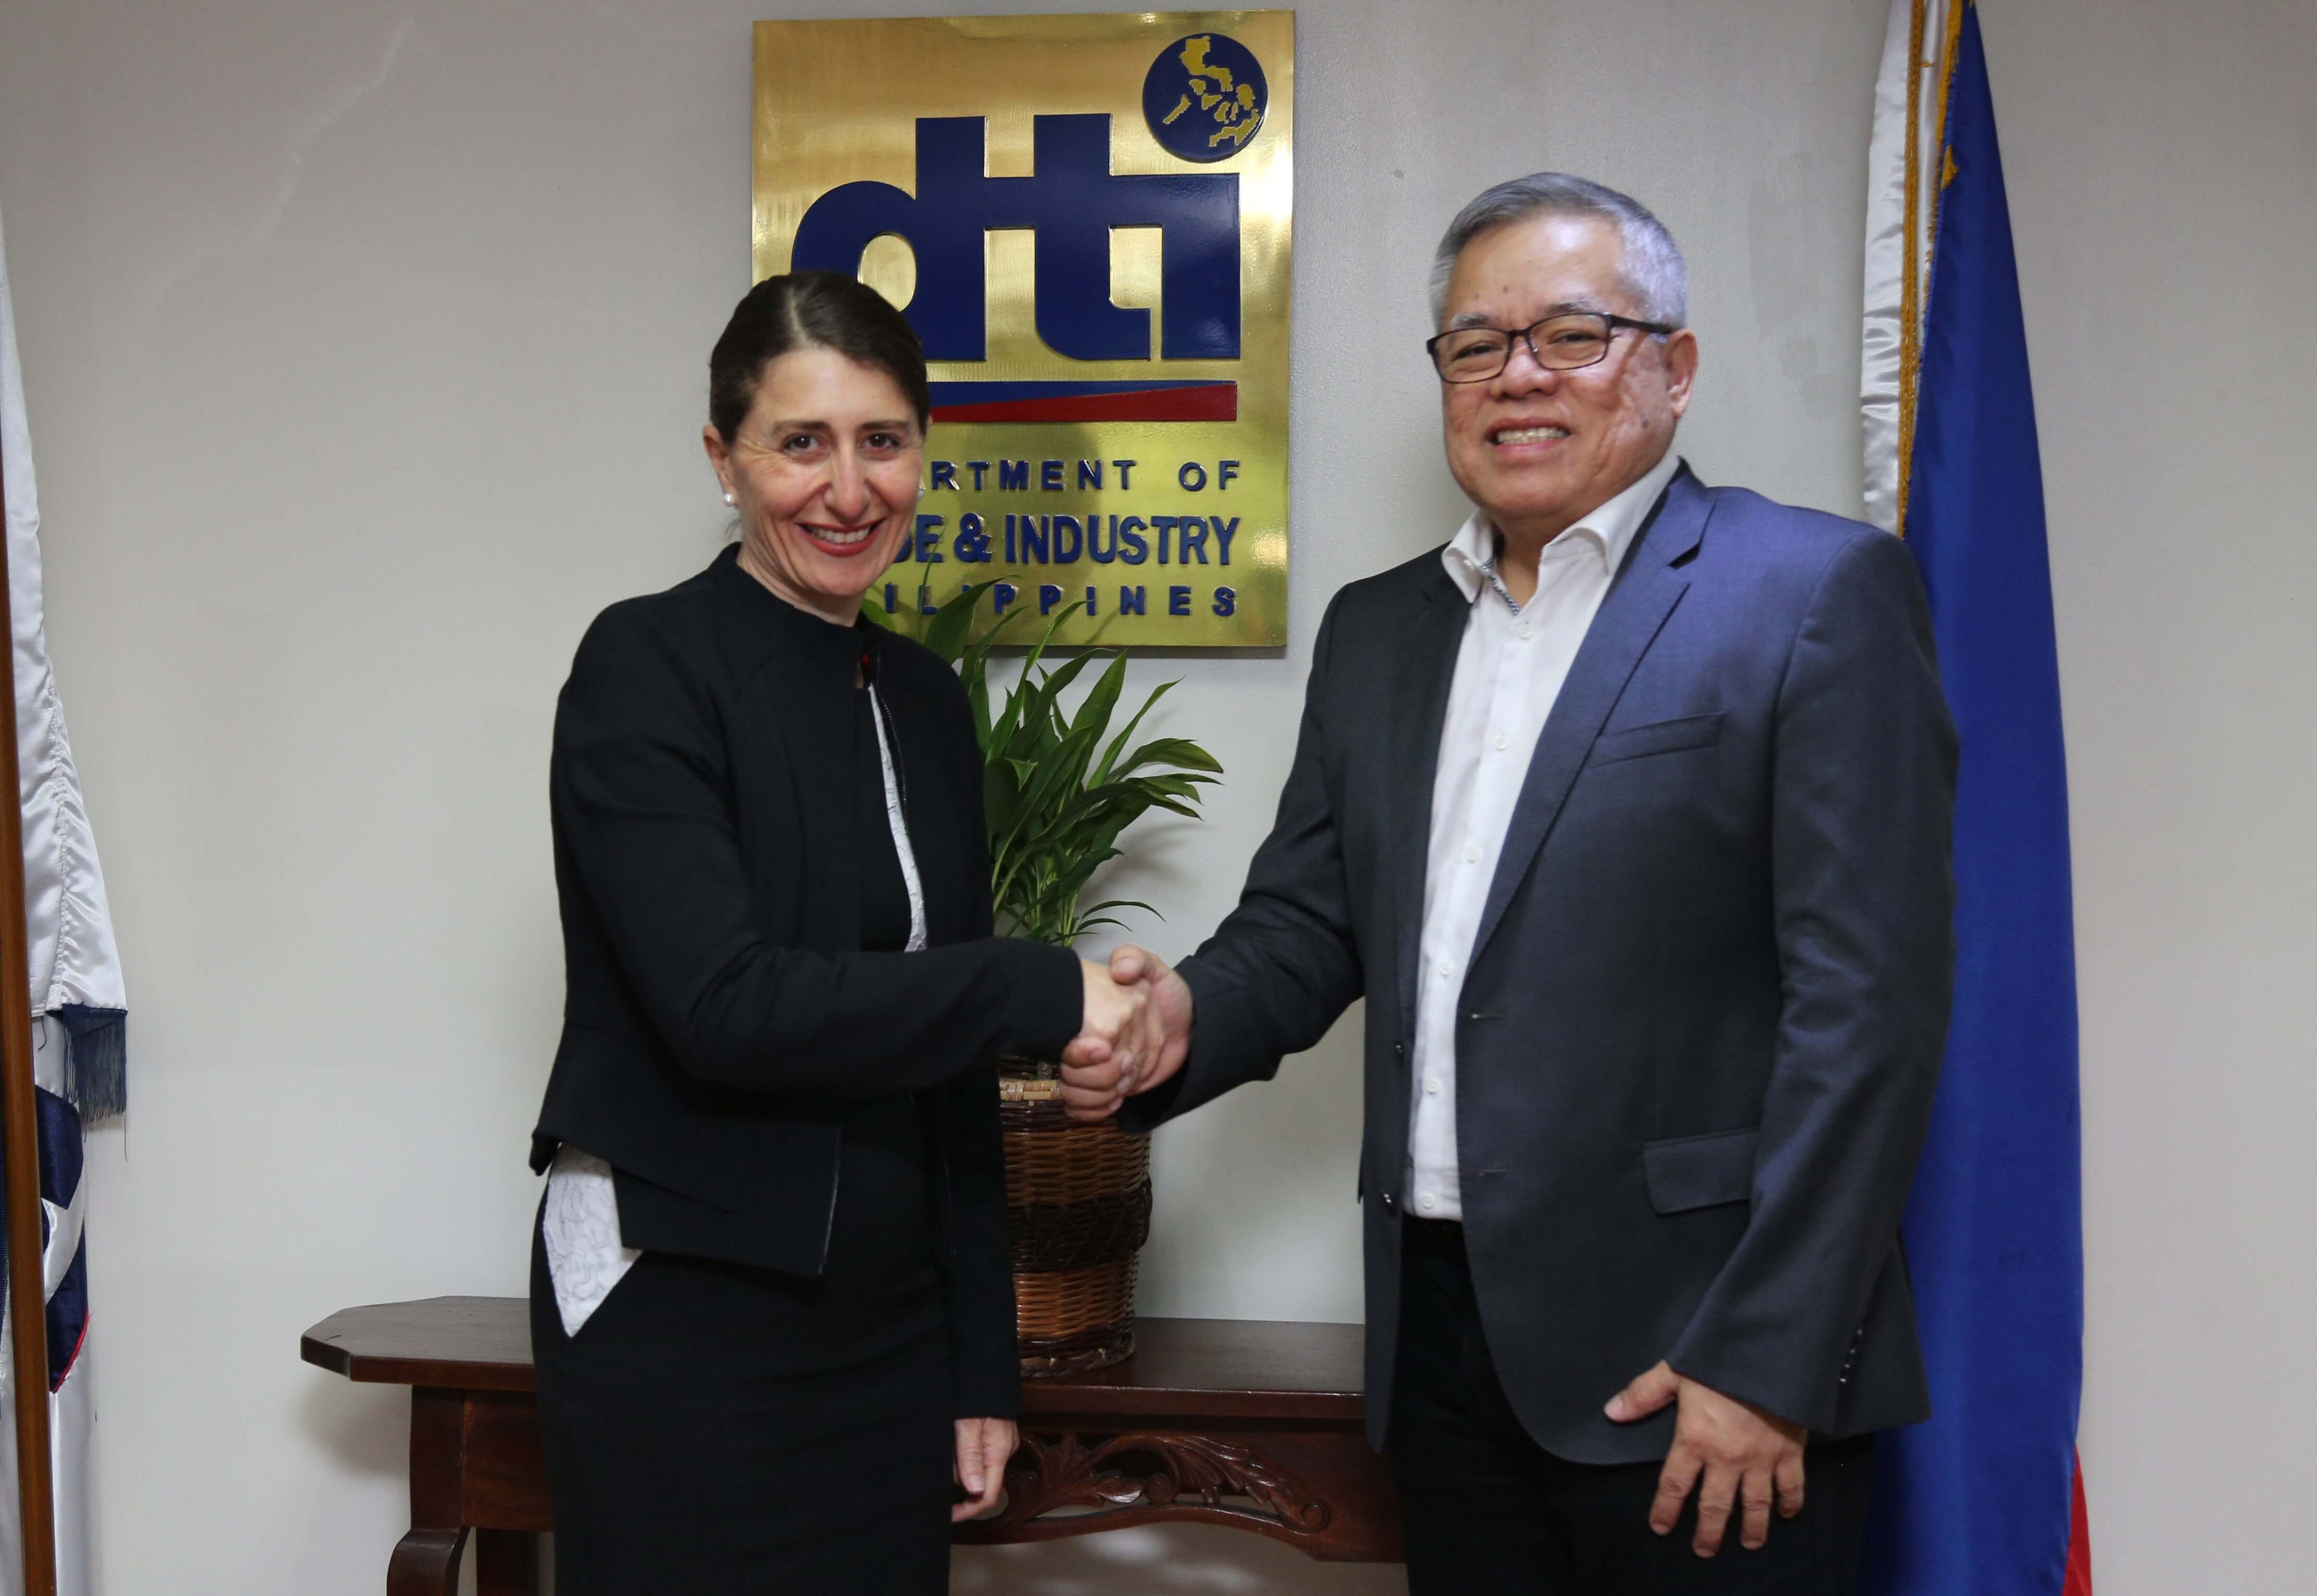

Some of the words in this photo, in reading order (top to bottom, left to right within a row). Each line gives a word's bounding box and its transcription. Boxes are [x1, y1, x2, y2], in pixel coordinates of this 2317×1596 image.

[919, 459, 1136, 491] RTMENT
[1178, 460, 1240, 491] OF
[954, 512, 993, 563] &
[1005, 514, 1240, 565] INDUSTRY
[884, 583, 1236, 617] ILPPINES
